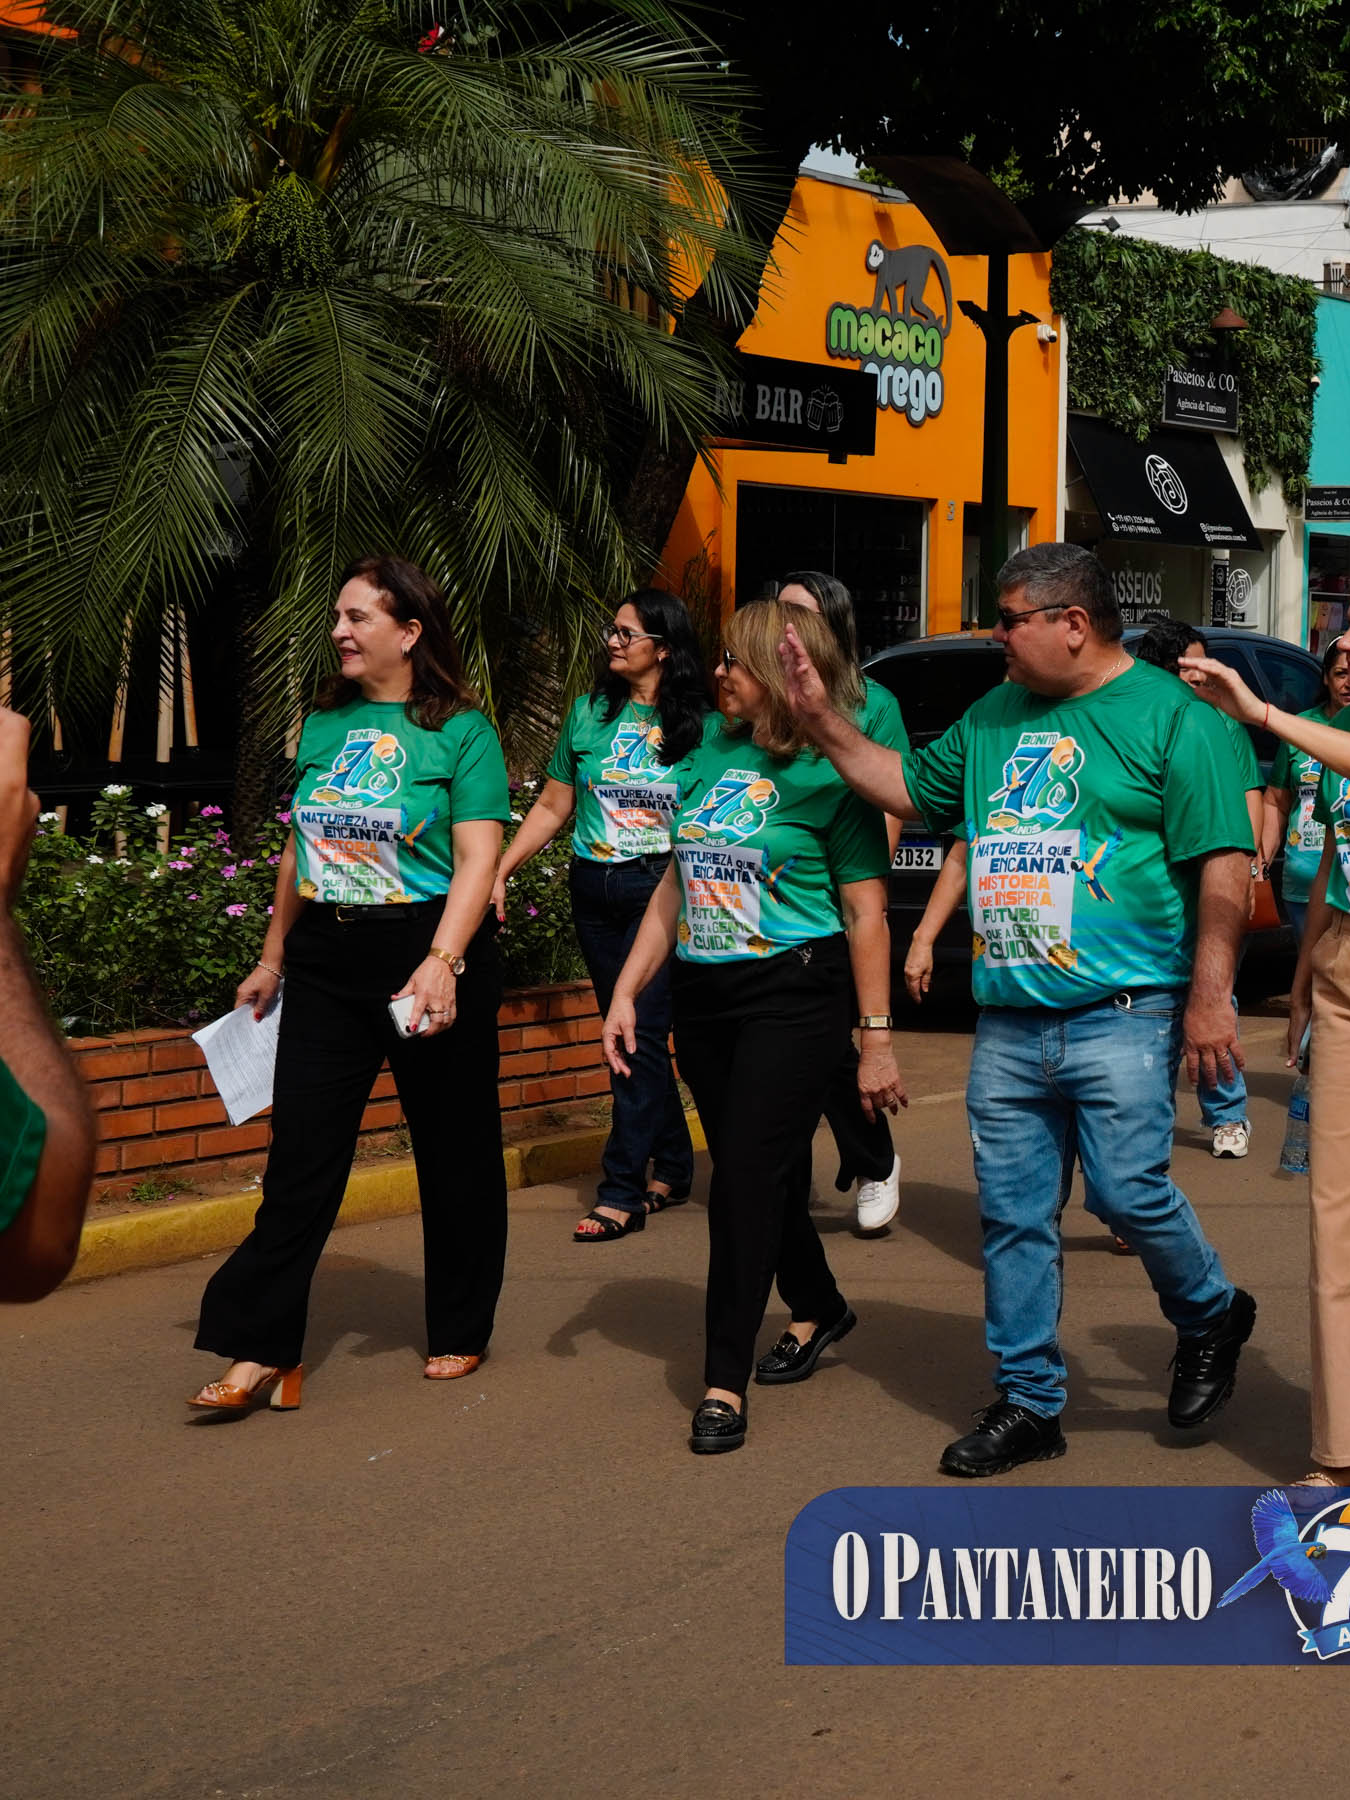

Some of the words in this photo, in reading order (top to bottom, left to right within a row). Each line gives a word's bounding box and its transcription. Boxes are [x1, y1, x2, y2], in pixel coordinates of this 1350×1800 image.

[831, 307, 942, 368] macaco
[1167, 364, 1206, 388] Passeios
[1207, 372, 1216, 388] &
[755, 383, 804, 425] BAR
[1177, 397, 1198, 411] Agência
[1198, 399, 1206, 411] de
[1206, 401, 1227, 415] Turismo
[1306, 498, 1332, 506] Passeios
[1121, 608, 1135, 623] SEU
[349, 730, 381, 740] BONITO
[1021, 734, 1059, 746] BONITO
[328, 734, 406, 797] 78
[724, 770, 760, 782] BONITO
[1002, 737, 1086, 818] 78
[599, 789, 655, 799] NATUREZA
[656, 793, 673, 801] QUE
[693, 778, 780, 837] 78
[300, 811, 368, 828] NATUREZA
[371, 819, 394, 830] QUE
[1011, 824, 1043, 835] ANOS
[702, 836, 728, 847] ANOS
[976, 840, 1044, 858] NATUREZA
[1047, 845, 1073, 857] QUE
[677, 850, 733, 866] NATUREZA
[735, 858, 756, 871] QUE
[894, 848, 935, 867] 3D32
[978, 896, 993, 908] QUE
[982, 907, 1040, 923] FUTURO
[692, 922, 706, 935] QUE
[986, 928, 1003, 941] QUE
[1004, 928, 1011, 938] A
[1012, 922, 1061, 940] GENTE
